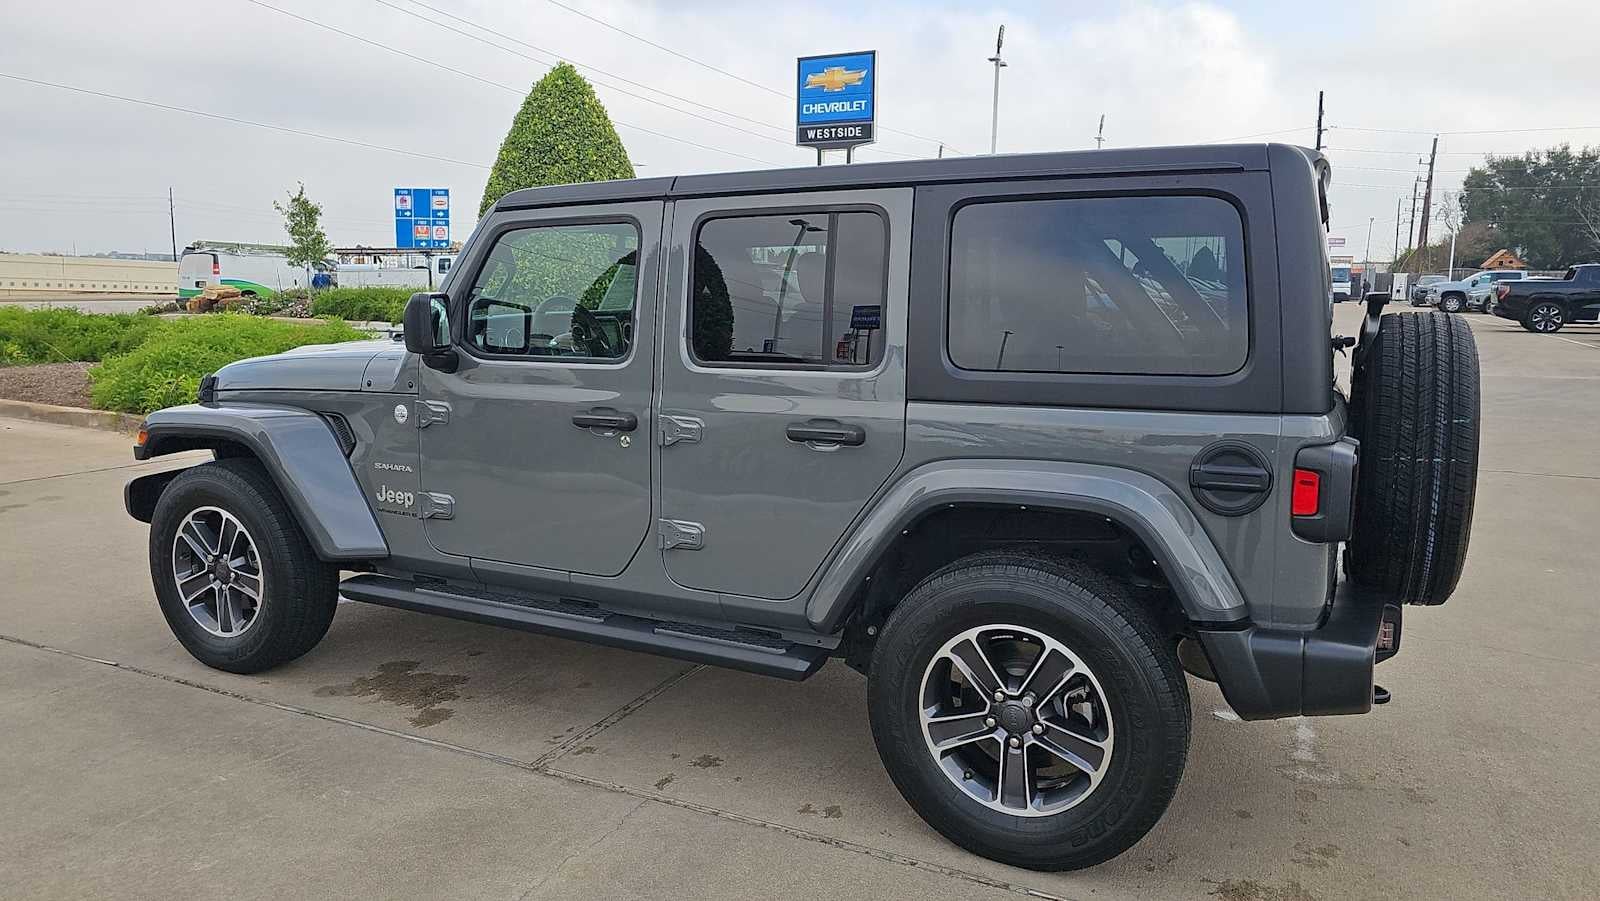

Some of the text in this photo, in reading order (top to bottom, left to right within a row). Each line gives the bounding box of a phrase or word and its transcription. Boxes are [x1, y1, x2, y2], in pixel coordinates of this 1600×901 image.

[803, 100, 867, 114] CHEVROLET
[807, 127, 862, 139] WESTSIDE
[374, 462, 412, 472] SAHARA
[376, 485, 414, 508] Jeep
